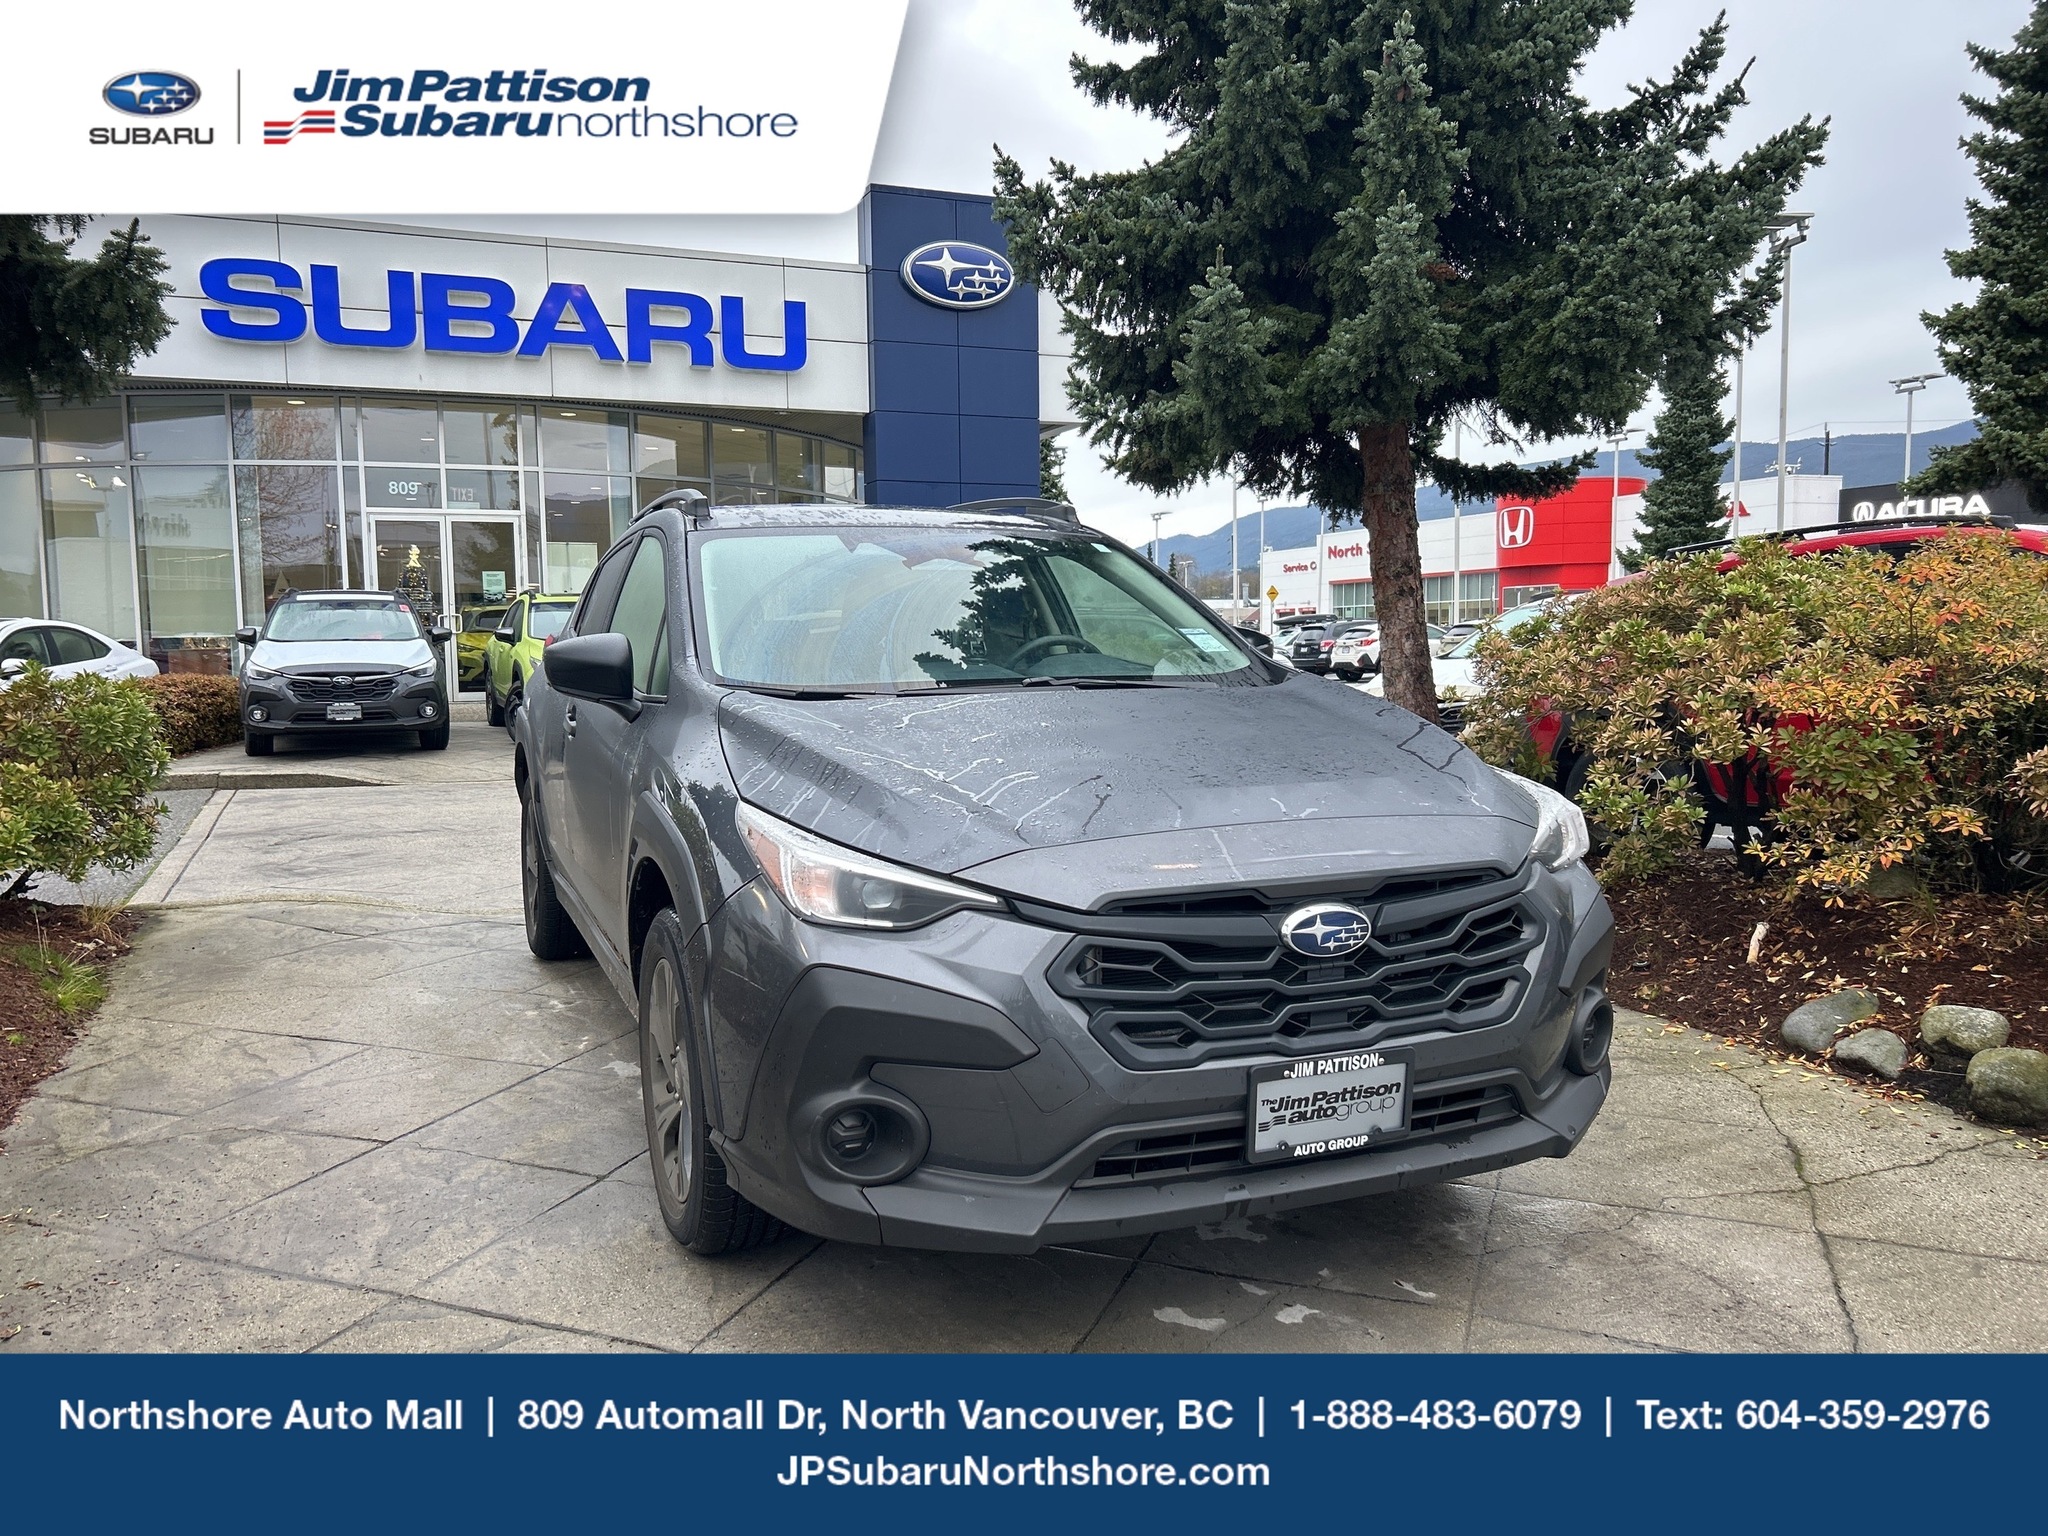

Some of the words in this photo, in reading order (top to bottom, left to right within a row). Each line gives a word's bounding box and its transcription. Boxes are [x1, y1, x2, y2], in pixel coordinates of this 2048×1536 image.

[199, 258, 807, 373] SUBARU
[388, 481, 418, 495] 809
[1875, 494, 1991, 520] ACURA
[1327, 543, 1363, 559] North
[1283, 563, 1309, 573] Service
[1290, 1061, 1315, 1079] JIM
[1317, 1052, 1379, 1075] PATTISON
[1261, 1098, 1278, 1107] The
[1311, 1081, 1402, 1106] Pattison
[1269, 1095, 1310, 1113] Jim
[1293, 1141, 1326, 1157] AUTO
[1328, 1135, 1369, 1151] GROUP
